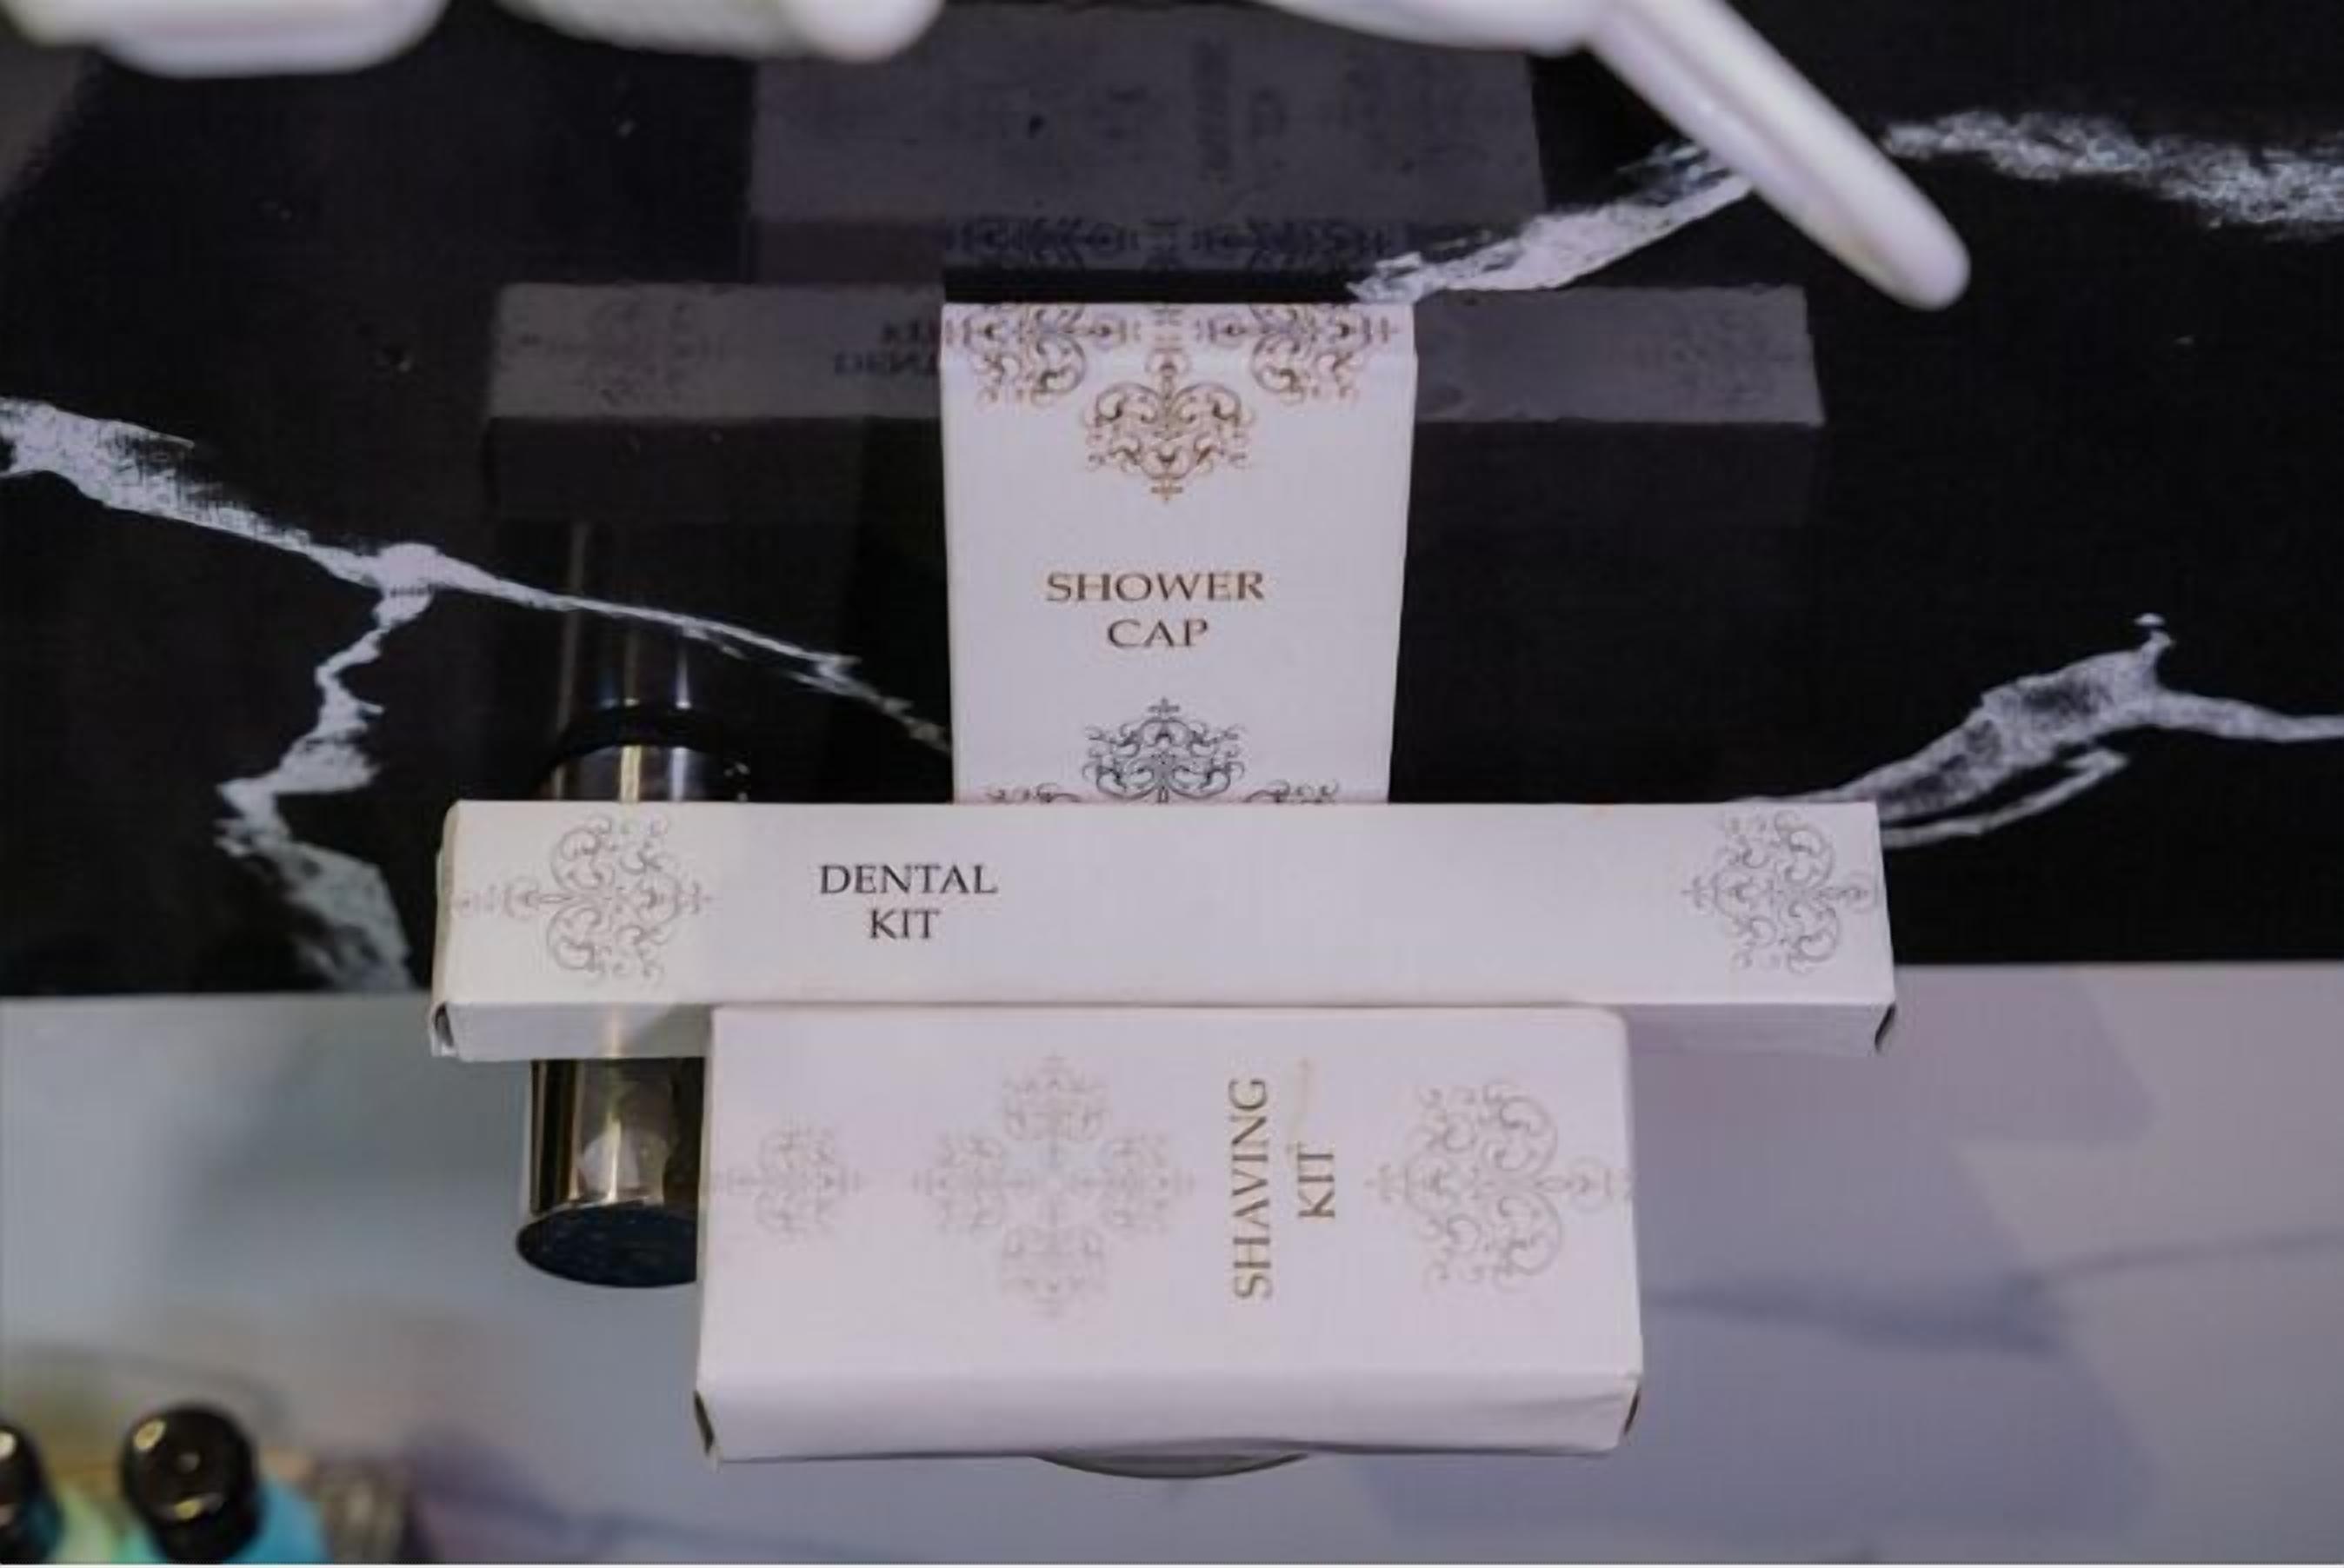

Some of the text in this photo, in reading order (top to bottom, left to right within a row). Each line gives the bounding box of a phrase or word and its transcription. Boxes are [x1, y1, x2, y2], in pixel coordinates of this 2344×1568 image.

[1046, 571, 1265, 601] SHOWER
[1107, 618, 1208, 648] CAP
[820, 864, 998, 894] DENTAL
[869, 909, 940, 940] KIT
[1228, 1078, 1273, 1299] SHAVING
[1296, 1141, 1335, 1219] KIT
